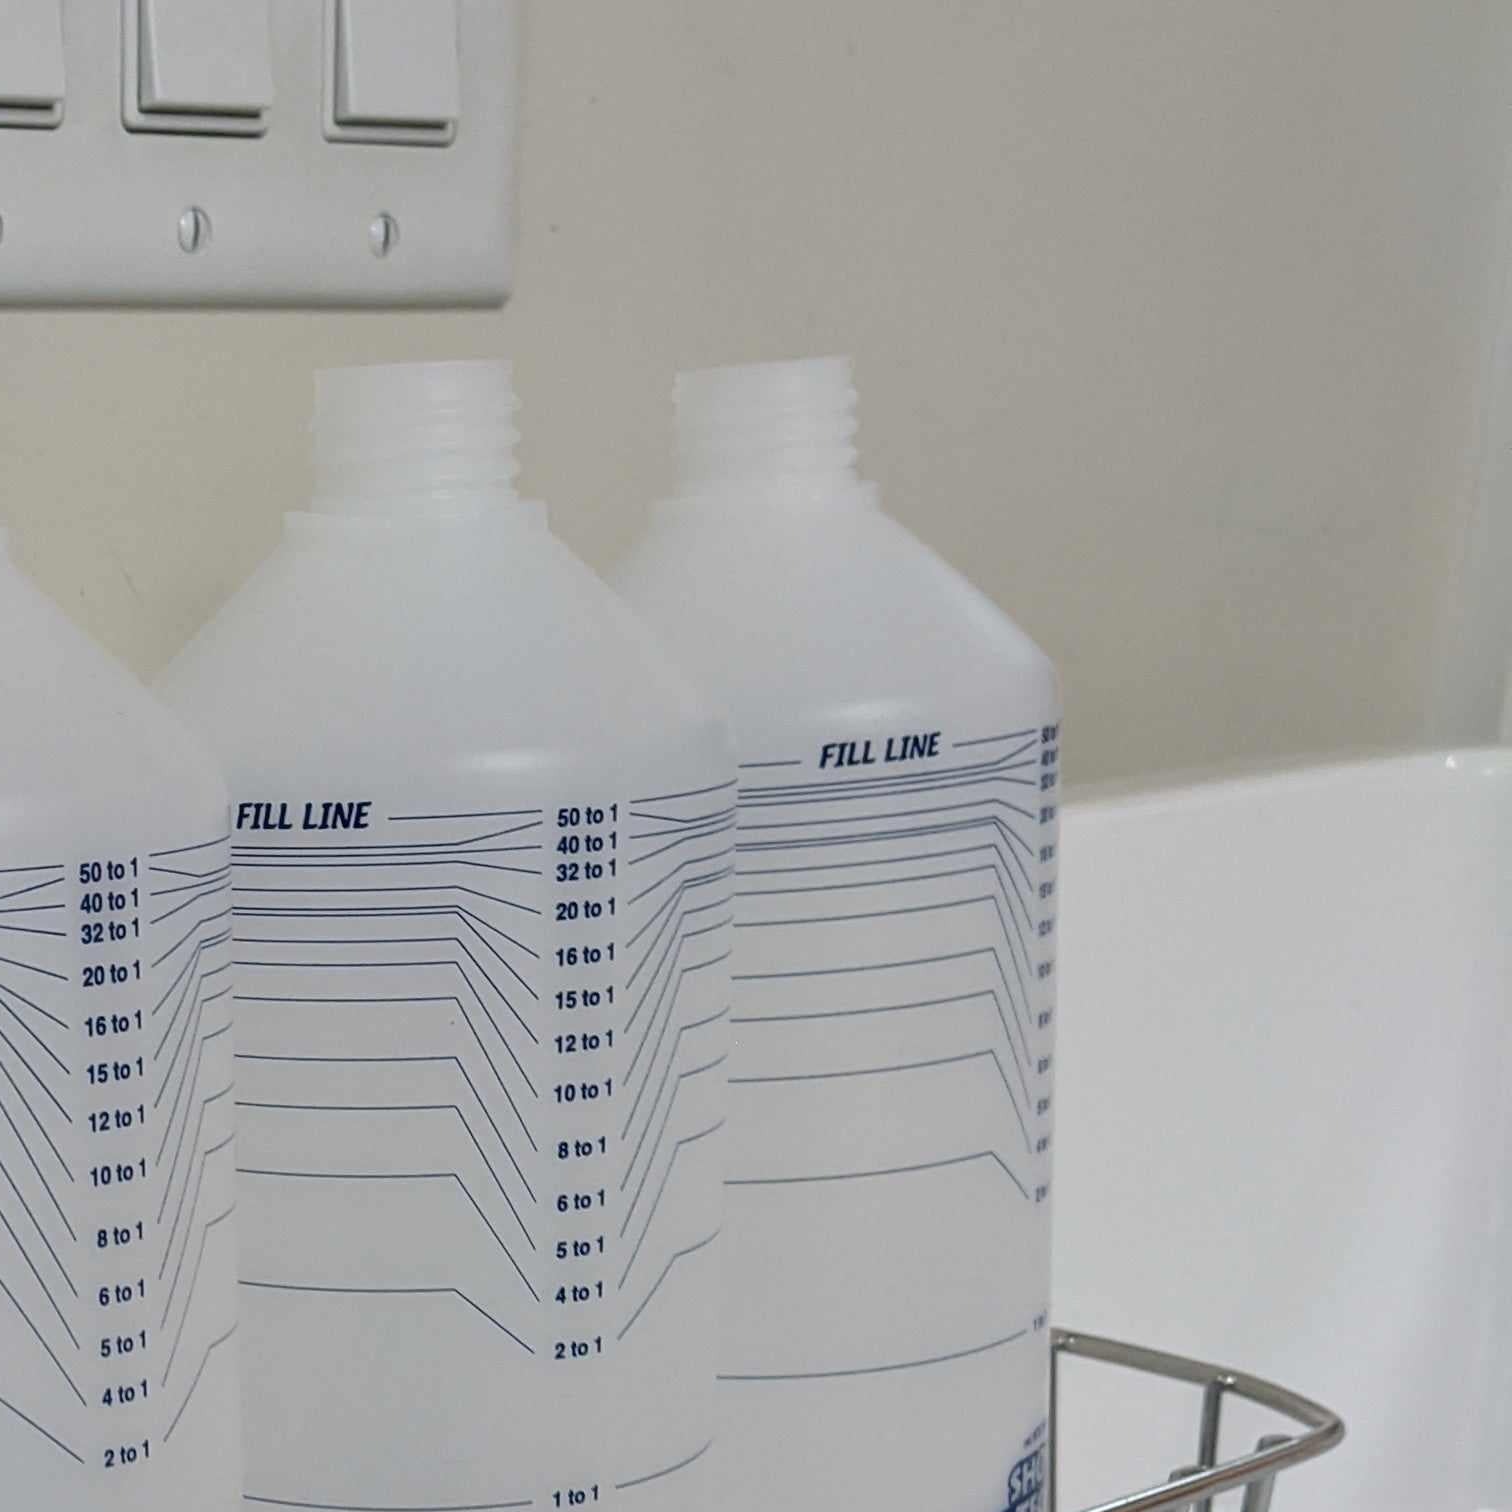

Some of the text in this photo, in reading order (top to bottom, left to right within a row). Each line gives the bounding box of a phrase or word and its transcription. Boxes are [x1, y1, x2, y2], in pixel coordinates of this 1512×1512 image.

[819, 731, 943, 768] FILL LINE
[236, 801, 372, 829] FILL LINE
[556, 803, 618, 828] 50 to 1
[556, 831, 617, 855] 40 to 1
[79, 856, 138, 885] 50 to 1
[555, 858, 617, 883] 32 to 1
[79, 887, 139, 914] 40 to 1
[555, 896, 616, 922] 20 to 1
[80, 917, 139, 945] 32 to 1
[555, 942, 615, 968] 16 to 1
[82, 959, 141, 988] 20 to 1
[554, 985, 614, 1011] 15 to 1
[84, 1009, 142, 1038] 16 to 1
[554, 1029, 613, 1055] 12 to 1
[86, 1056, 144, 1085] 15 to 1
[553, 1077, 612, 1104] 10 to 1
[88, 1103, 145, 1133] 12 to 1
[557, 1135, 606, 1160] 8 to 1
[89, 1157, 146, 1188] 10 to 1
[556, 1188, 605, 1213] 6 to 1
[96, 1220, 143, 1249] 8 to 1
[555, 1235, 604, 1260] 5 to 1
[98, 1278, 145, 1307] 6 to 1
[554, 1280, 603, 1305] 4 to 1
[100, 1329, 146, 1358] 5 to 1
[554, 1335, 602, 1360] 2 to 1
[101, 1379, 148, 1407] 4 to 1
[103, 1439, 150, 1469] 2 to 1
[552, 1484, 599, 1508] 1 to 1
